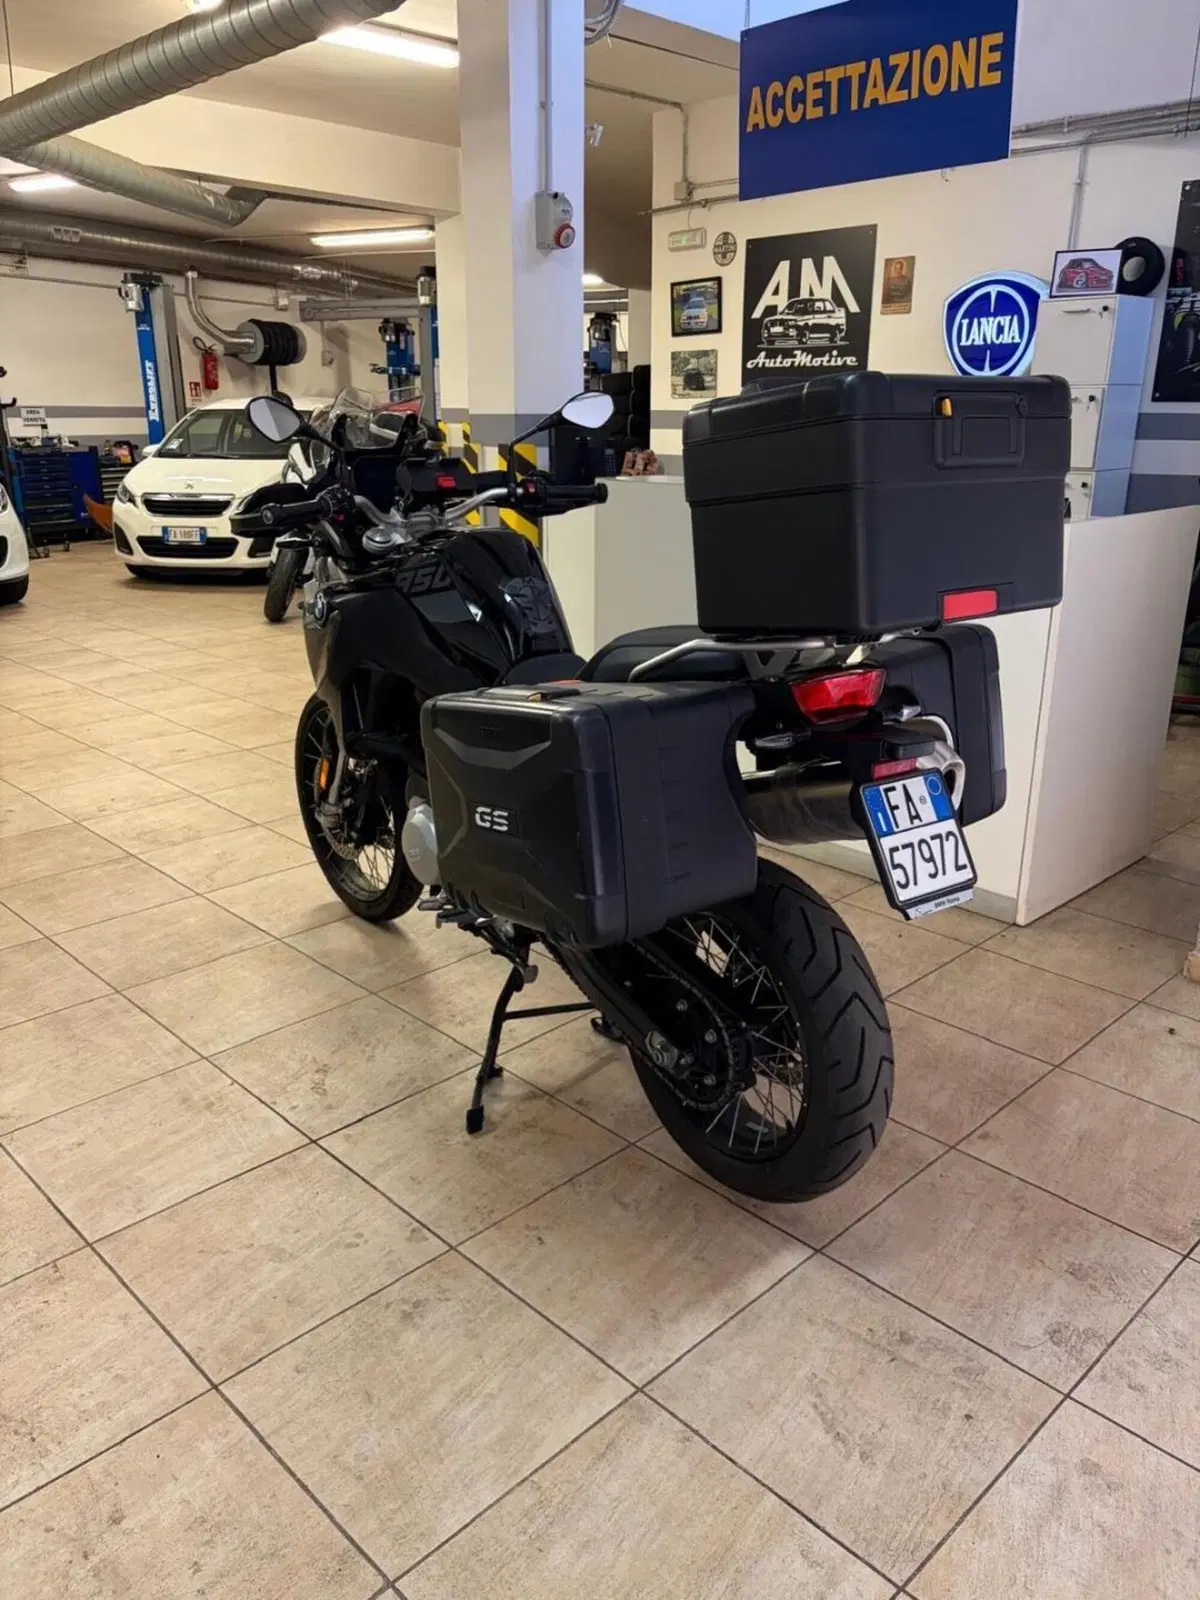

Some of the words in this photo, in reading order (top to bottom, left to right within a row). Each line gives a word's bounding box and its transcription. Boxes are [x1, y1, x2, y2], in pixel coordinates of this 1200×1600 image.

[746, 31, 1003, 132] ACCETTAZIONE
[751, 255, 861, 319] AM
[960, 315, 1021, 346] LANCIA
[746, 350, 858, 369] AutoMotive
[475, 806, 509, 831] GS
[883, 783, 923, 829] FA
[888, 830, 968, 890] 57972
